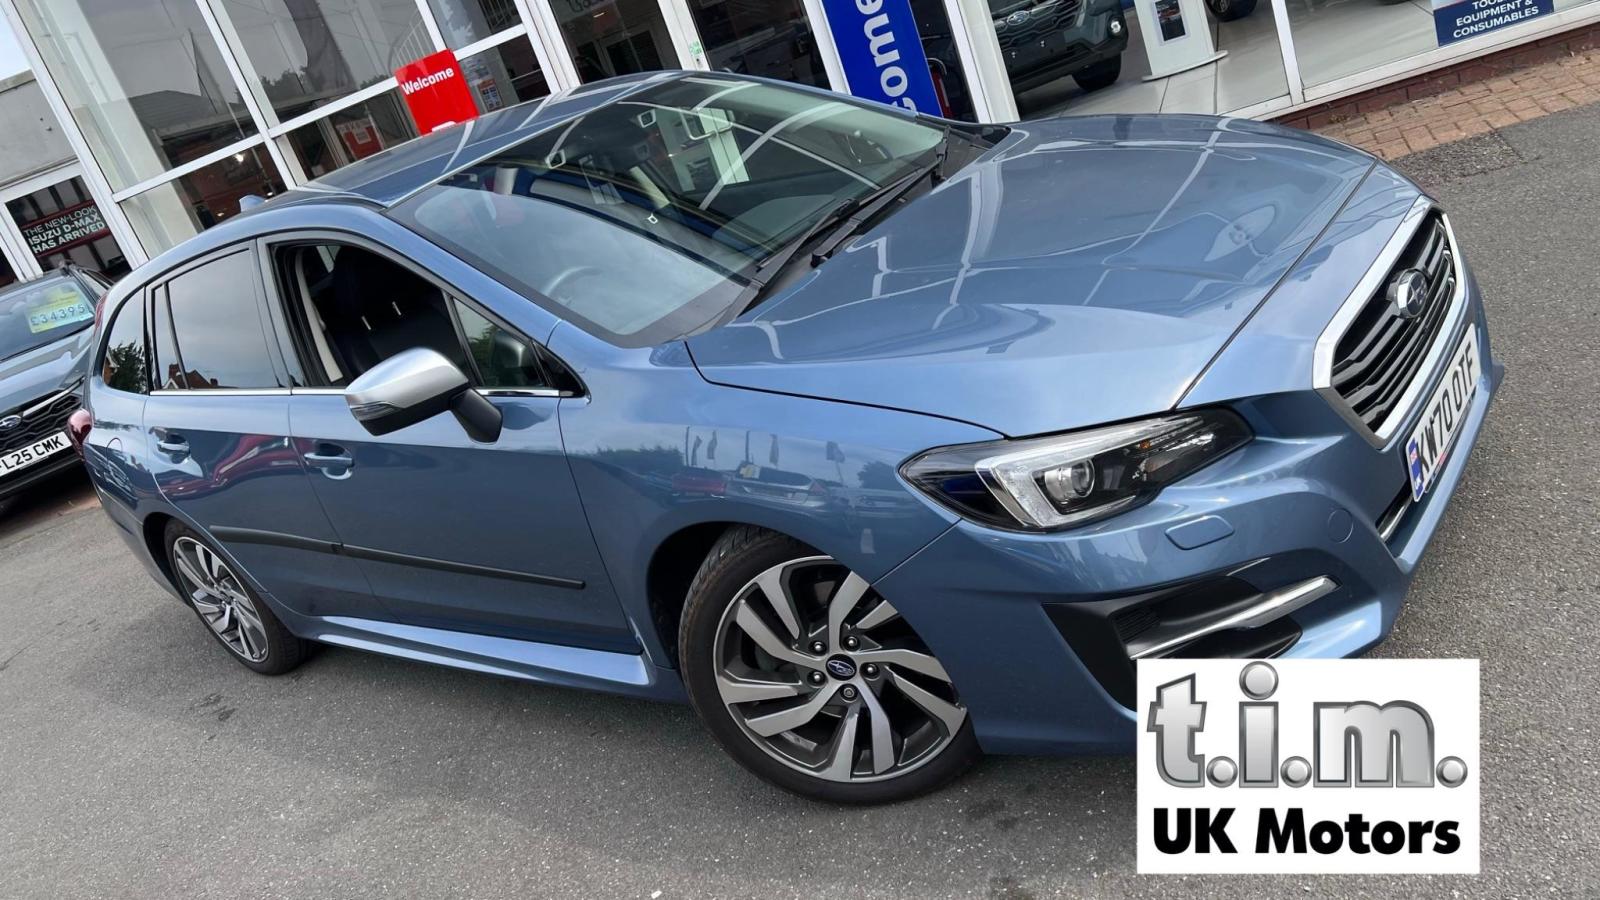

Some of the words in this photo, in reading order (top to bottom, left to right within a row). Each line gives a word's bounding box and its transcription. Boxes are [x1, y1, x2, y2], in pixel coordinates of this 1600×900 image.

[1453, 6, 1539, 38] CONSUMABLES
[1456, 0, 1521, 27] EQUIPMENT
[401, 67, 455, 95] Welcome
[24, 225, 45, 237] THE
[28, 227, 62, 245] ISUZU
[62, 213, 101, 233] D-MAX
[32, 239, 57, 254] HAS
[58, 220, 106, 245] ARRIVED
[30, 303, 86, 326] £34395
[1416, 388, 1453, 484] KW70
[1452, 341, 1474, 412] OTF
[0, 448, 33, 470] L25
[33, 435, 64, 456] CMK
